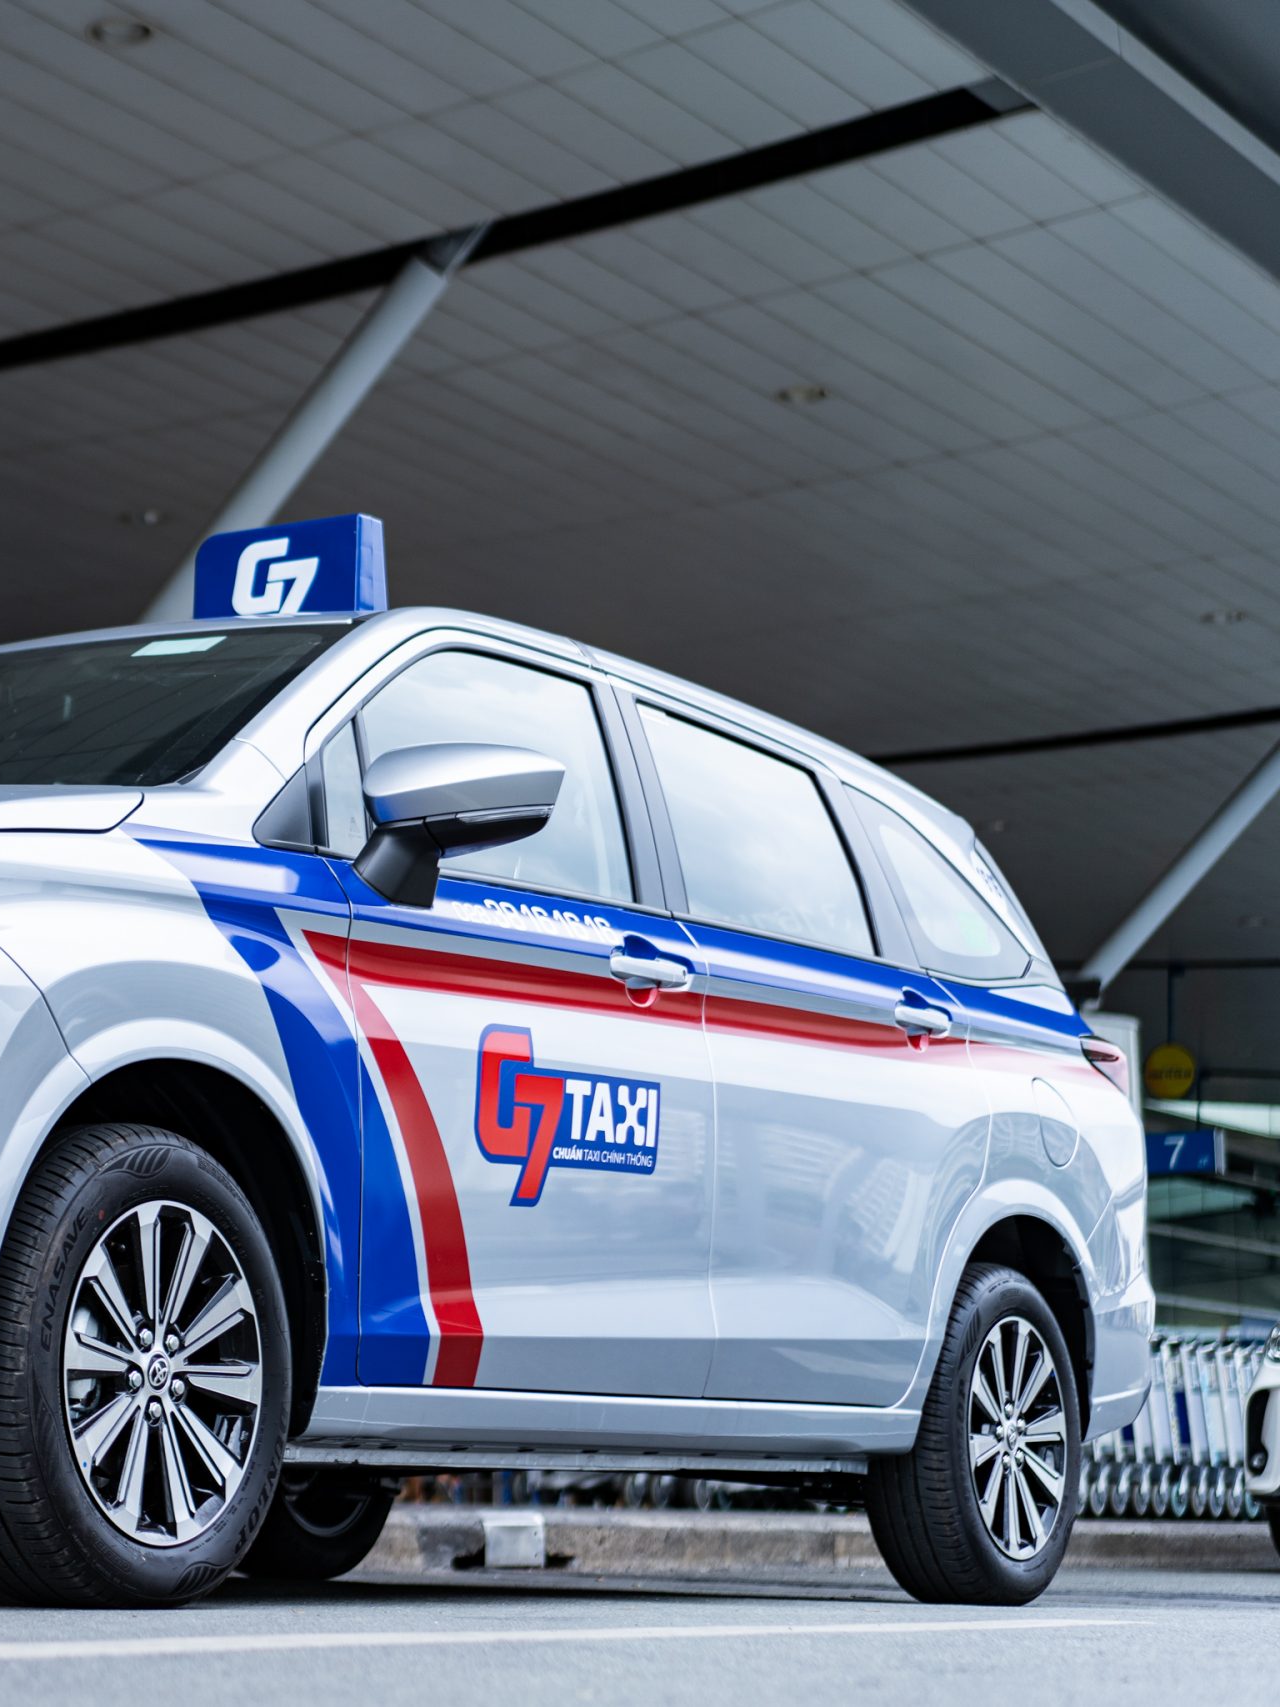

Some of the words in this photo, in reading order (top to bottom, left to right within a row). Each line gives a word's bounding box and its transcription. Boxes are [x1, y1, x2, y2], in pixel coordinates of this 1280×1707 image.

[231, 536, 320, 617] G7
[475, 1026, 565, 1204] G7
[565, 1078, 658, 1149] TAXI
[583, 1148, 600, 1163] TAXI
[600, 1149, 626, 1165] CHÍNH
[626, 1151, 654, 1168] THỐNG
[1163, 1134, 1186, 1171] 7
[41, 1206, 89, 1352] ENASAVE
[235, 1402, 288, 1554] DUNLOP
